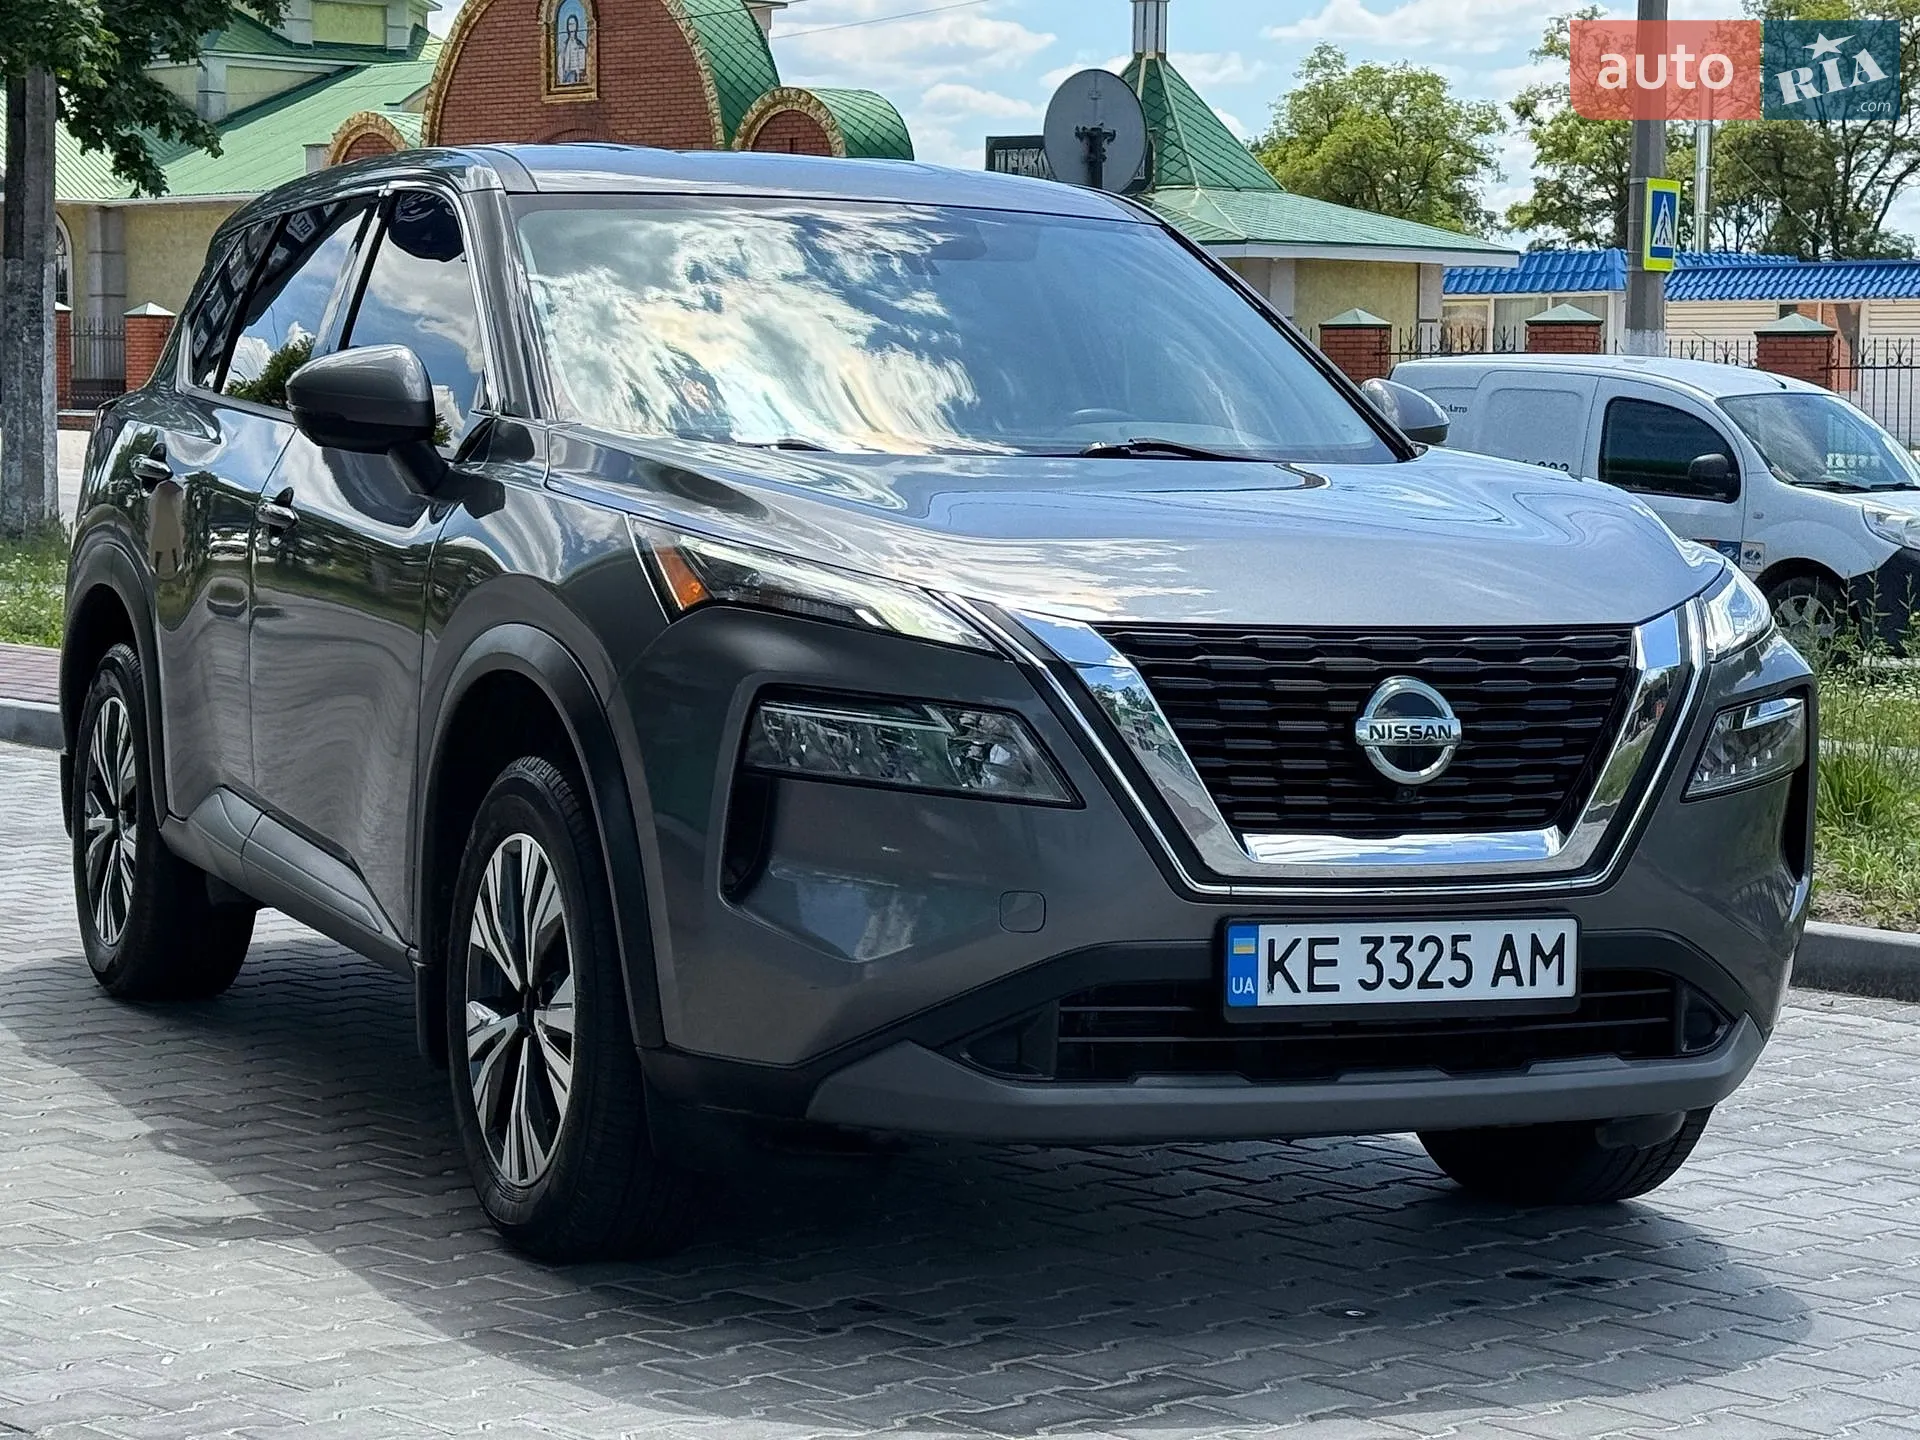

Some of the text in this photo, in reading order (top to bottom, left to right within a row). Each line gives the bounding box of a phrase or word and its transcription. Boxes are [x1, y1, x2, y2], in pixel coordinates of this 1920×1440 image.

[1369, 724, 1452, 740] NISSAN
[1267, 932, 1566, 994] KE 3325 AM
[1232, 976, 1256, 995] UA
